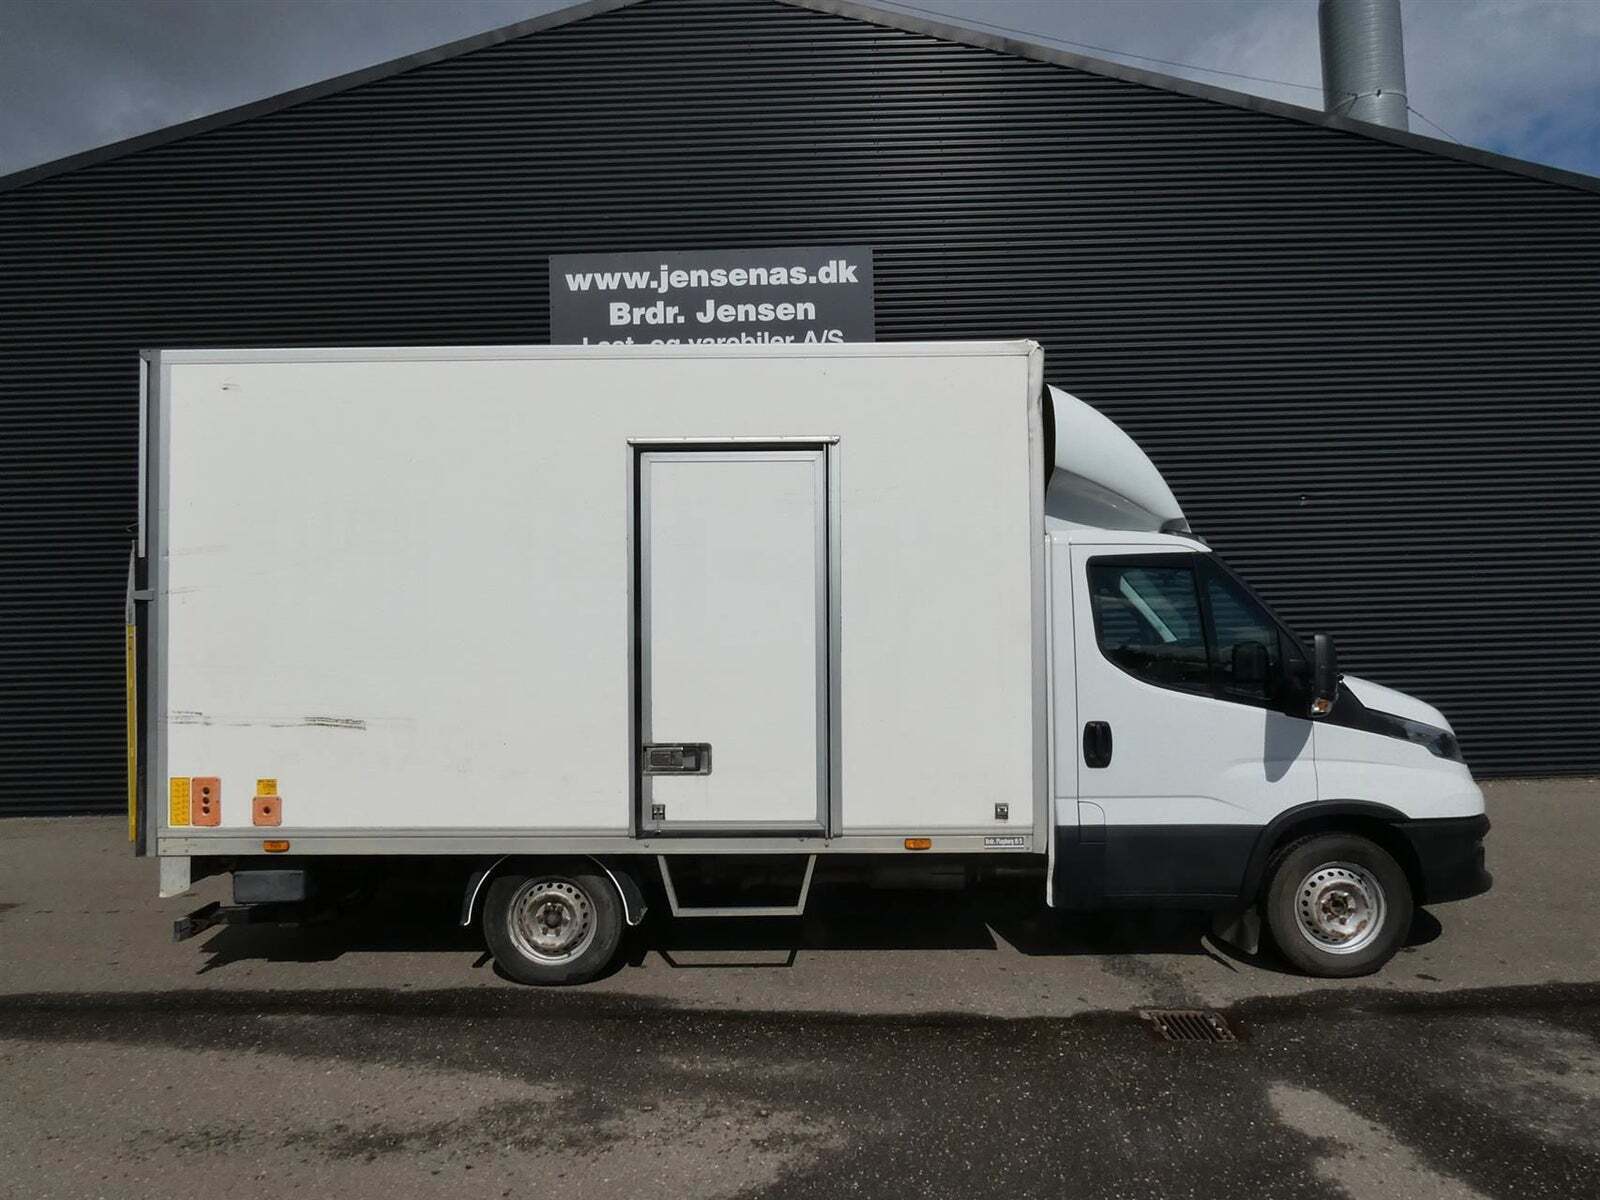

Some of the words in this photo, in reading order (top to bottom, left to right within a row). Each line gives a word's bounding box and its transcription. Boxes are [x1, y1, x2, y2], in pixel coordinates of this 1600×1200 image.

[565, 260, 858, 293] www.jensenas.dk
[609, 301, 685, 325] Brdr.
[696, 299, 816, 323] Jensen
[803, 329, 844, 344] A/S
